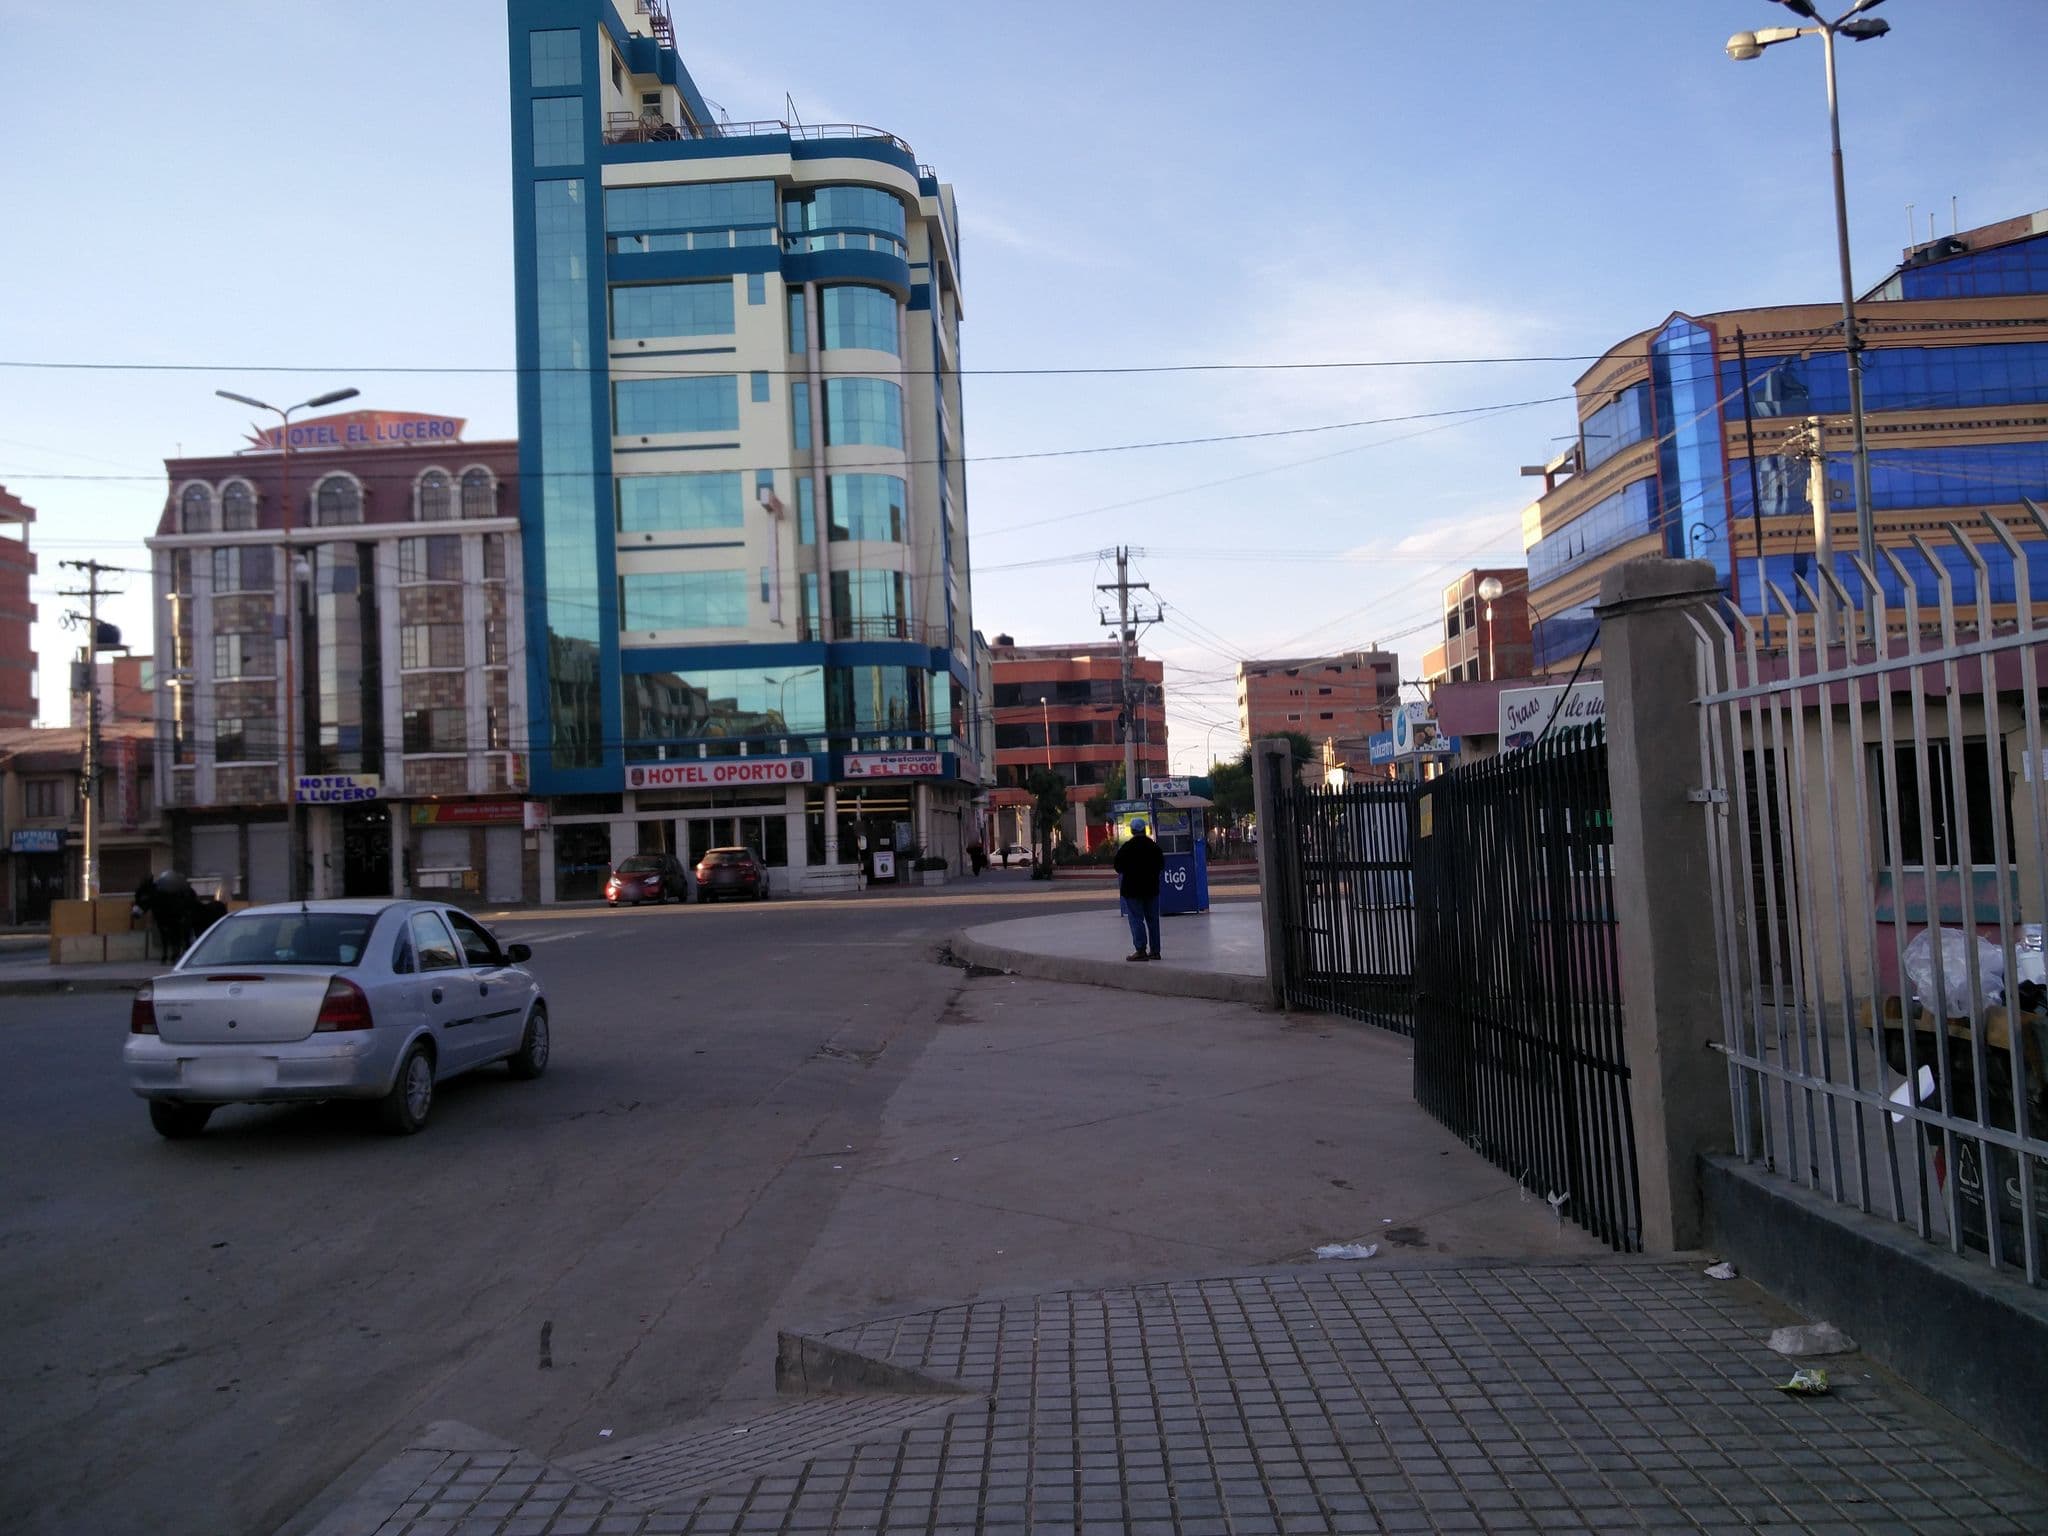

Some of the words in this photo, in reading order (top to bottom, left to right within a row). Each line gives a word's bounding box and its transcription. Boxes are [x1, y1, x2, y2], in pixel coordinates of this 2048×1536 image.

[276, 427, 339, 446] HOTEL
[347, 424, 369, 442] EL
[376, 420, 455, 440] LUCERO
[1507, 697, 1540, 730] Trans
[648, 767, 708, 784] HOTEL
[713, 763, 787, 781] OPORTO
[870, 764, 894, 775] EL
[300, 777, 356, 789] HOTEL
[310, 787, 377, 801] LUCERO
